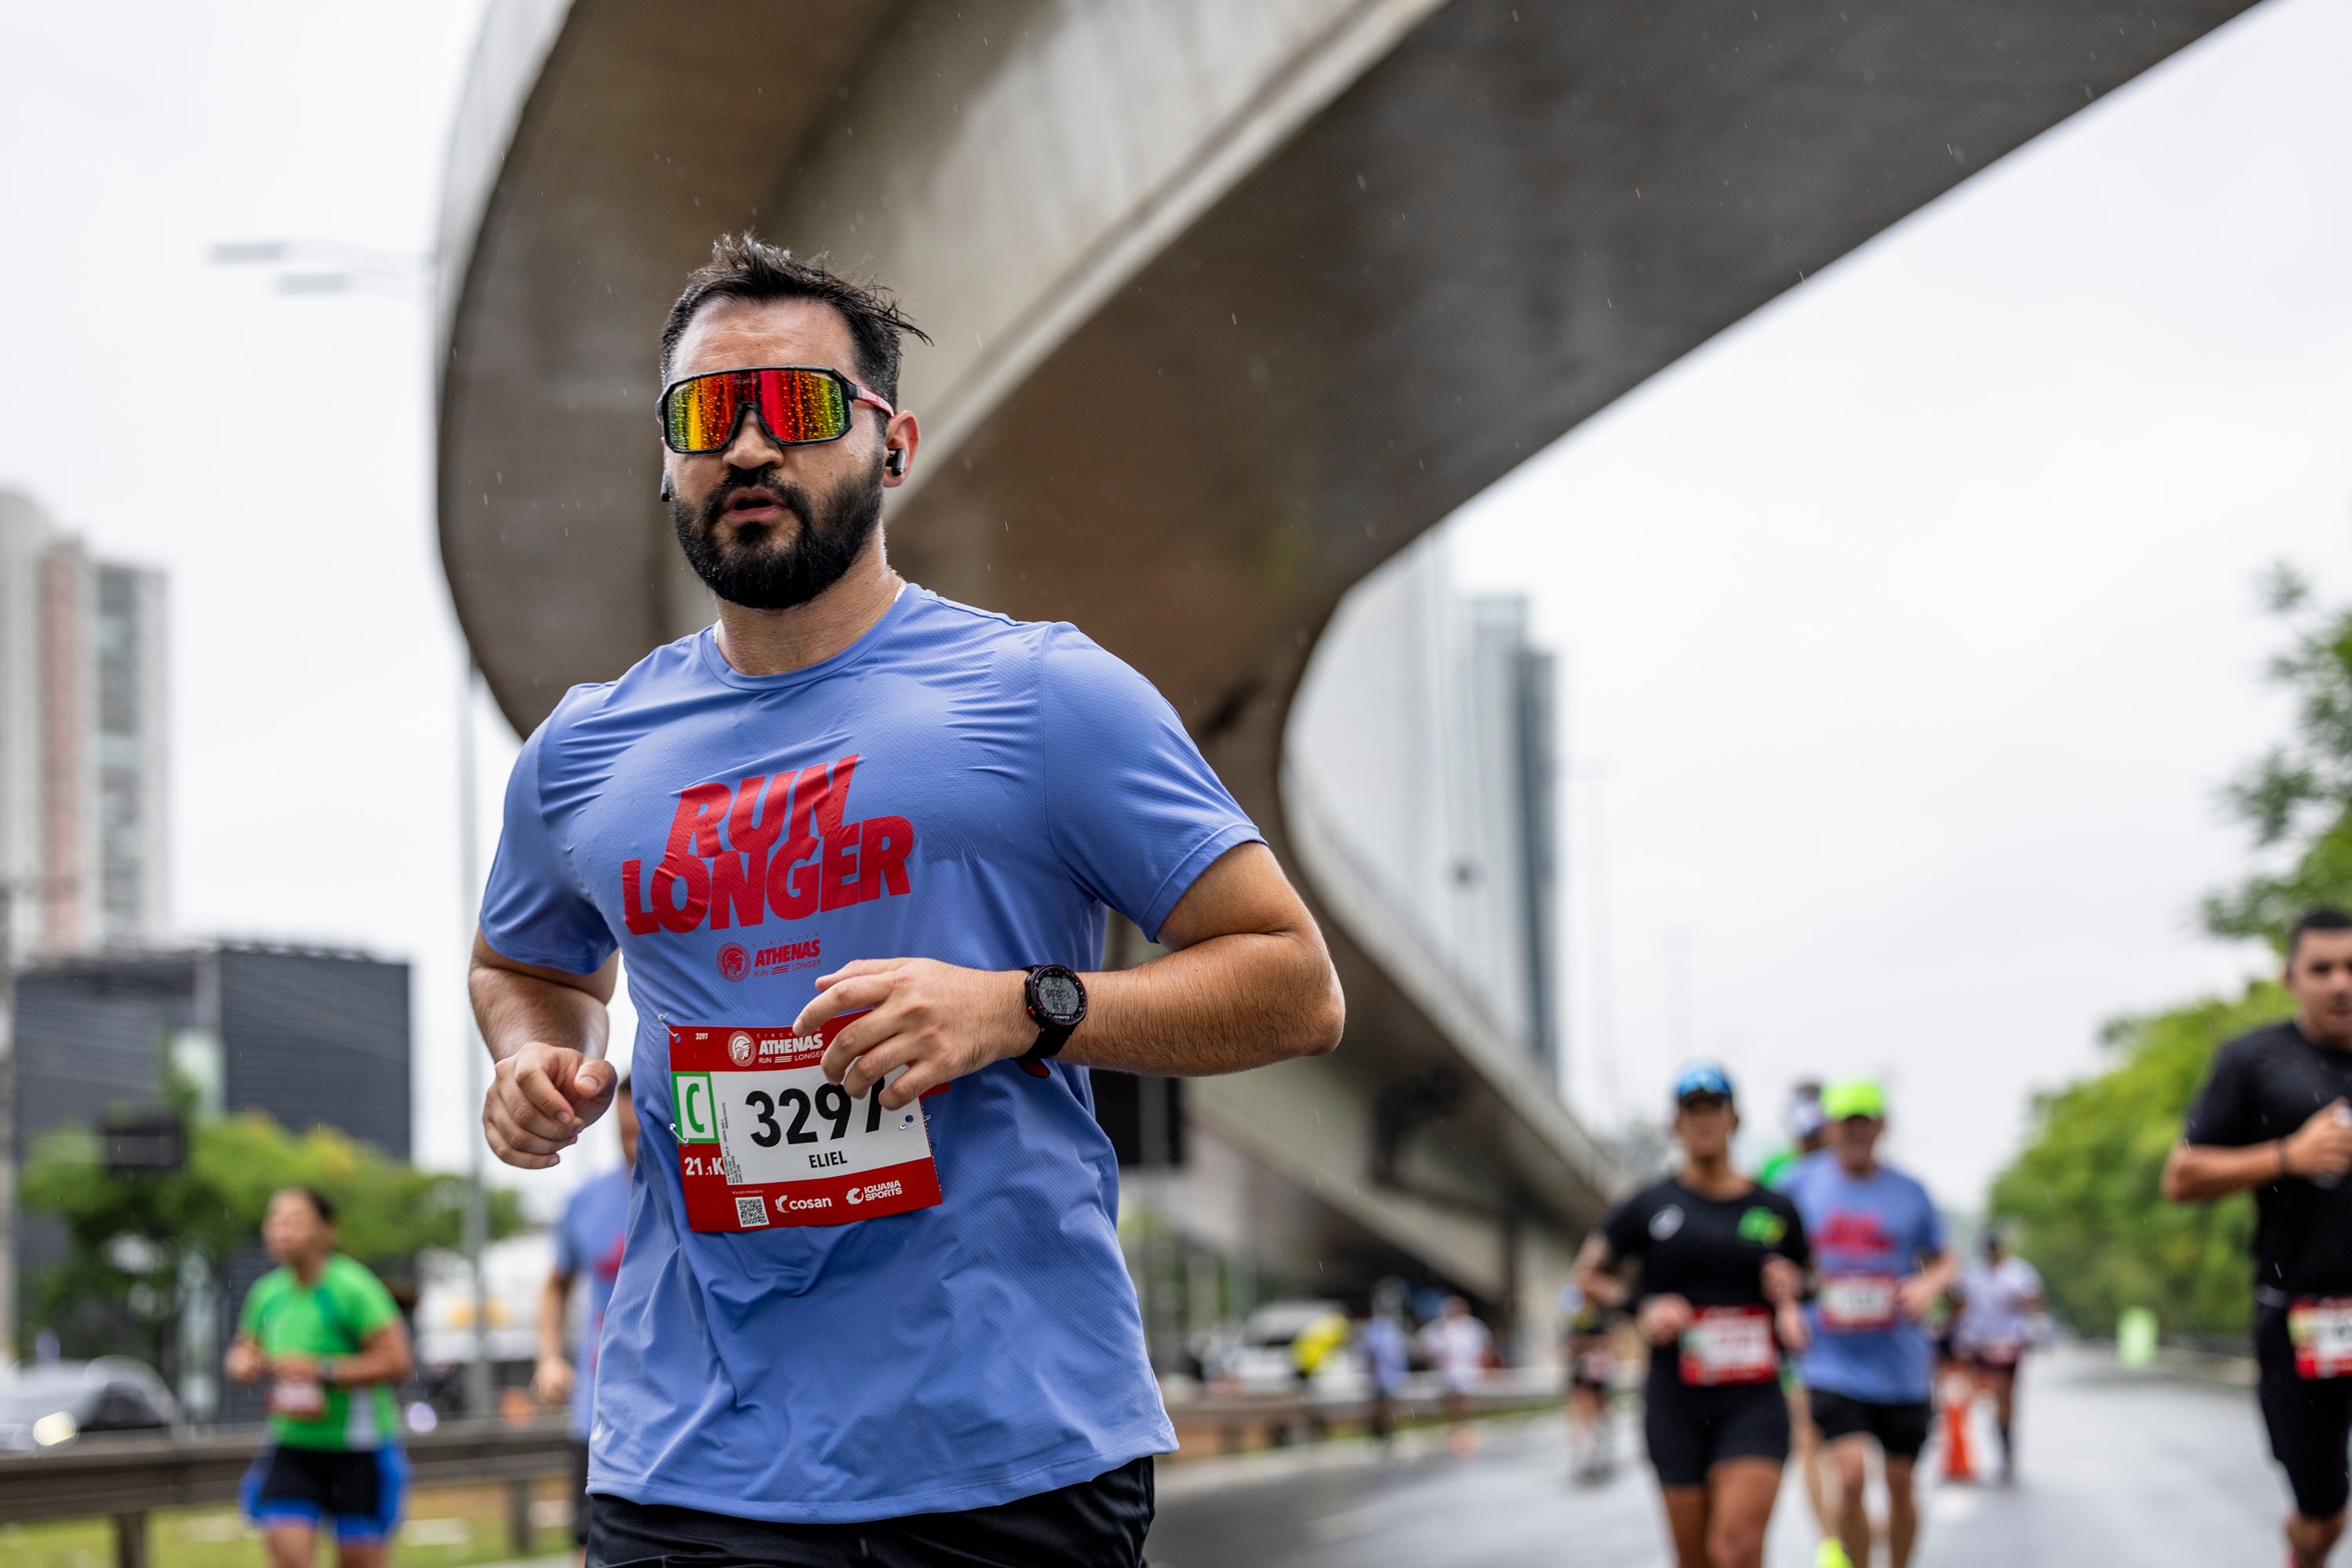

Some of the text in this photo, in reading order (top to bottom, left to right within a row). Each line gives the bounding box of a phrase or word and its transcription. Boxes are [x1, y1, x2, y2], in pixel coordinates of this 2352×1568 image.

[665, 753, 860, 858] RUN
[622, 815, 914, 935] LONGER
[754, 938, 821, 967] ATHENAS
[792, 959, 822, 971] LONGER
[757, 1026, 821, 1039] CIRCUO
[758, 1033, 824, 1055] ATHENAS
[794, 1050, 826, 1062] LONGER
[686, 1083, 705, 1134] C
[745, 1075, 885, 1148] 3297
[808, 1150, 848, 1169] ELIEL
[864, 1180, 902, 1193] IGUANA
[866, 1188, 902, 1201] SPORTS
[789, 1197, 833, 1210] cosan
